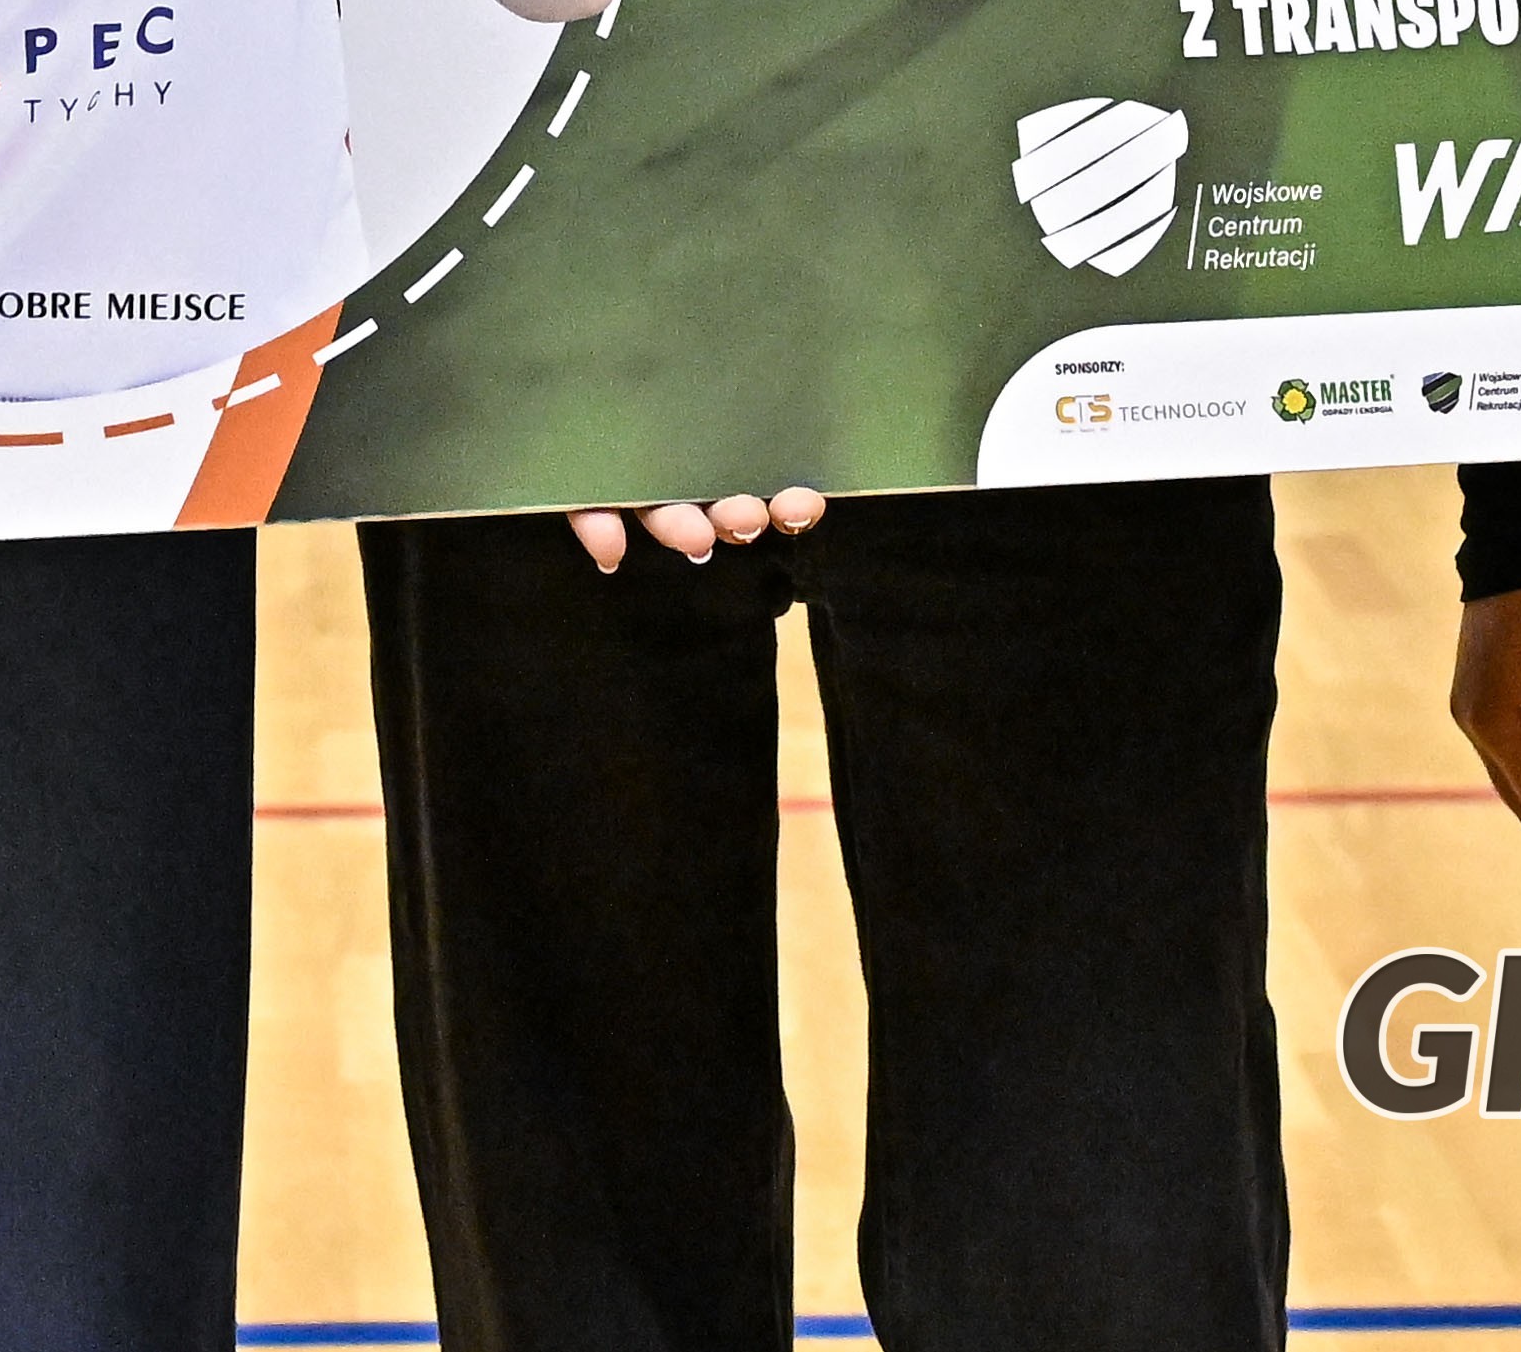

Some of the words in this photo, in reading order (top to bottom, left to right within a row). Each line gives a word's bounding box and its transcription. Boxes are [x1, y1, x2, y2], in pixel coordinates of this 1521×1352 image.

[23, 5, 175, 75] PEC
[1212, 181, 1323, 209] Wojskowe
[1208, 216, 1303, 238] Centrum
[1204, 243, 1317, 271] Rekrutacji
[107, 293, 247, 321] MIEJSCE
[1055, 361, 1125, 375] SPONSORZY:
[1319, 379, 1394, 405] MASTER
[1477, 386, 1519, 396] Centrum
[1119, 400, 1248, 423] TECHNOLOGY
